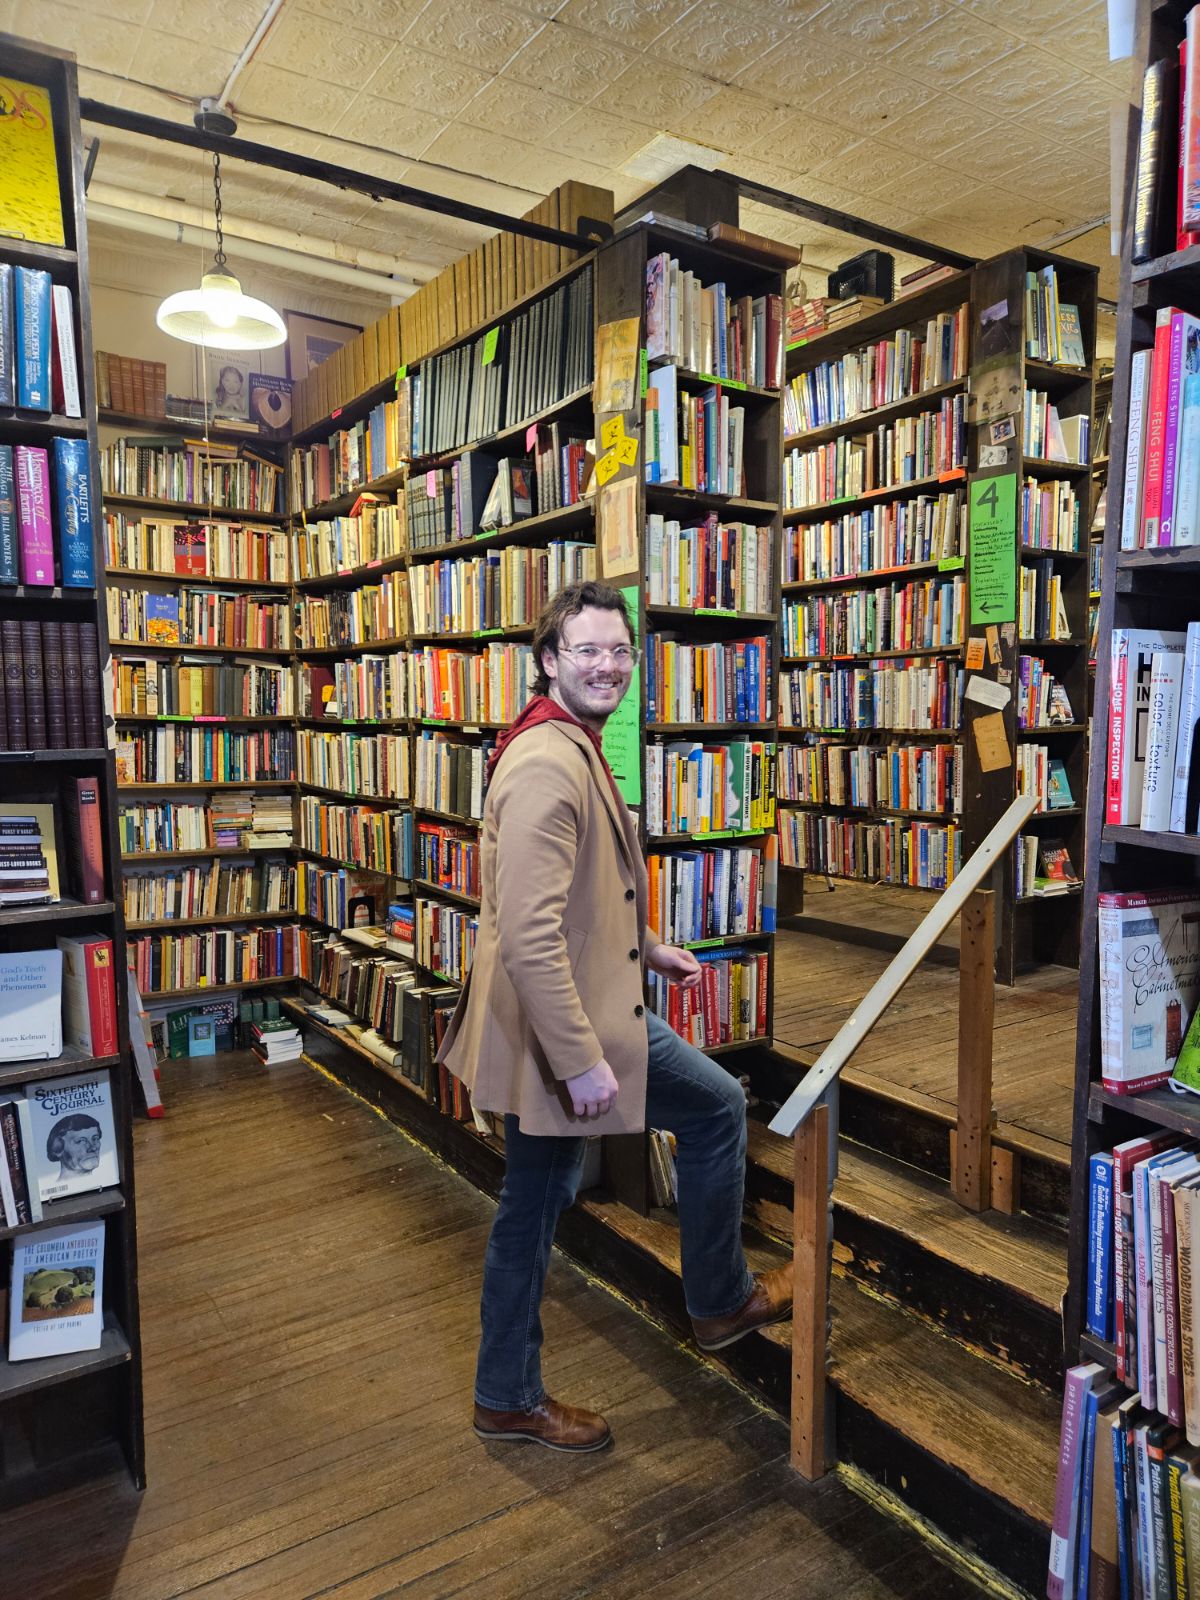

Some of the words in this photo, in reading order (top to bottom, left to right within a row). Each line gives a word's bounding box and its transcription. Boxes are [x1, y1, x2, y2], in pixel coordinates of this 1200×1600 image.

[1171, 335, 1181, 375] PRACTICAL
[1170, 378, 1180, 402] FENG
[1128, 399, 1143, 442] FENG
[1150, 411, 1163, 446] FENG
[1168, 405, 1178, 428] SHUI
[1126, 446, 1140, 483] SHUI
[1149, 452, 1161, 482] SHUI
[1166, 443, 1175, 467] SIMON
[0, 450, 8, 495] LANGUAGE
[30, 451, 44, 504] Masterpieces
[20, 488, 32, 526] Literature
[975, 481, 999, 518] 4
[2, 516, 10, 531] BILL
[35, 505, 50, 525] of
[3, 534, 13, 564] MOYERS
[1152, 643, 1185, 652] COMPLETE
[1113, 683, 1124, 713] HOME
[1153, 693, 1166, 726] color
[1111, 717, 1122, 780] INSPECTION
[1146, 744, 1163, 792] texture
[1, 965, 24, 975] God's
[25, 965, 46, 974] Teeth
[4, 974, 20, 982] and
[20, 974, 43, 982] Other
[1, 982, 47, 992] Phenomena
[20, 1033, 46, 1042] Kelman
[34, 1081, 99, 1101] SIXTEENTH
[41, 1089, 95, 1110] CENTURY
[50, 1095, 105, 1116] JOURNAL
[1097, 1185, 1105, 1203] Guide
[1095, 1210, 1105, 1237] Building
[1114, 1216, 1123, 1232] LOG
[1115, 1208, 1121, 1216] TO
[24, 1245, 34, 1255] THE
[37, 1242, 65, 1254] COLUMBIA
[67, 1238, 98, 1249] ANTHOLOGY
[1096, 1237, 1104, 1249] and
[1114, 1234, 1123, 1249] AND
[24, 1257, 33, 1266] OF
[36, 1252, 70, 1264] AMERICAN
[74, 1248, 98, 1260] POETRY
[1094, 1251, 1104, 1285] Remodeling
[1115, 1250, 1123, 1275] CEDAR
[1138, 1252, 1146, 1287] ADOBE
[1164, 1254, 1174, 1282] TIMBER
[1094, 1285, 1103, 1316] Materials
[1115, 1276, 1124, 1302] HOMES
[1165, 1284, 1175, 1312] FRAME
[1180, 1246, 1193, 1332] WOODBURNING
[1166, 1313, 1176, 1376] CONSTRUCTION
[1183, 1334, 1195, 1377] STOVES
[1066, 1384, 1076, 1415] paint
[1062, 1418, 1075, 1465] effects
[1150, 1463, 1161, 1494] Patios
[1167, 1465, 1182, 1511] Practical
[1153, 1497, 1162, 1514] and
[1153, 1518, 1166, 1564] Walkways
[1171, 1512, 1184, 1542] Guide
[1173, 1543, 1184, 1552] to
[1157, 1565, 1168, 1593] 1-2-3
[1174, 1554, 1187, 1584] Home
